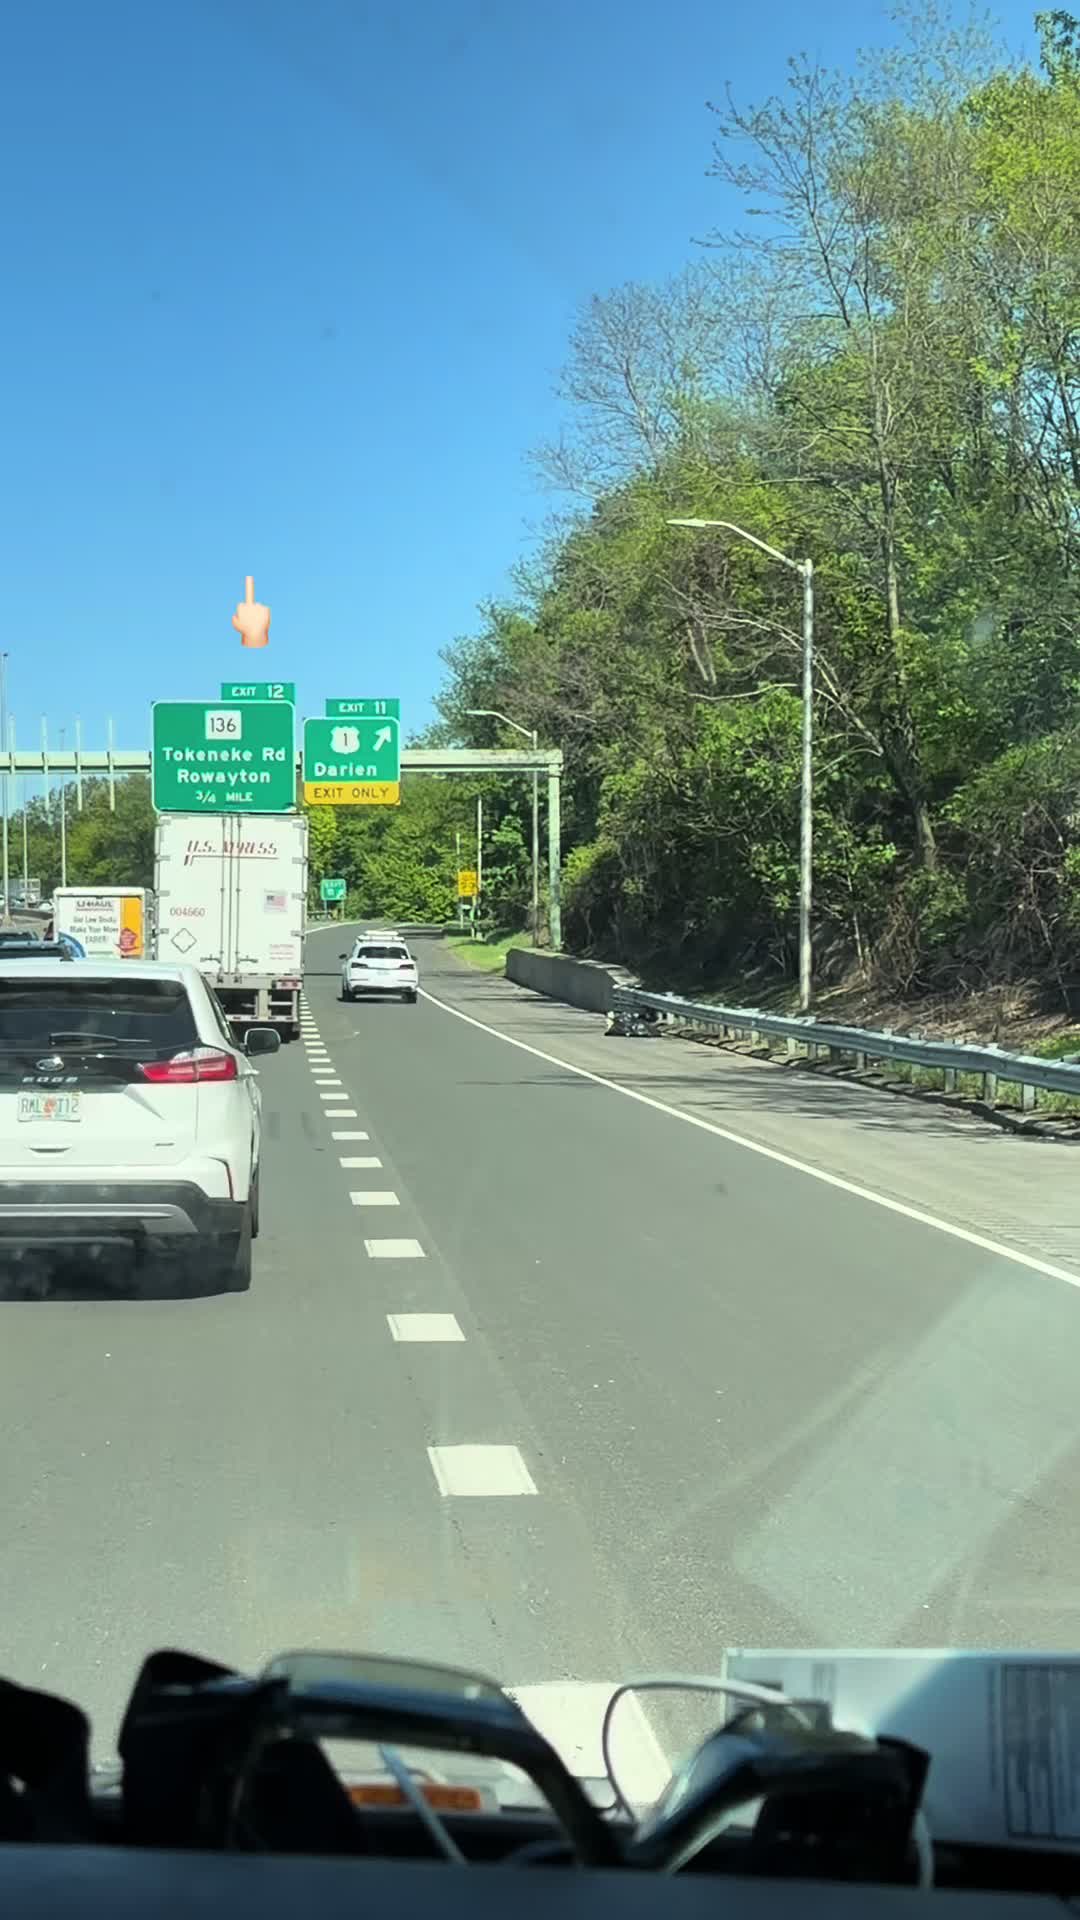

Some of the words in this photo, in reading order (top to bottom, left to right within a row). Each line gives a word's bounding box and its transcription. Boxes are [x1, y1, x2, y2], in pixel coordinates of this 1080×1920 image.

[231, 686, 256, 697] EXIT
[267, 684, 285, 698] 12
[339, 703, 364, 713] EXIT
[375, 701, 387, 714] 11
[209, 717, 237, 733] 136
[342, 732, 349, 747] 1
[162, 747, 253, 762] Tokeneke
[262, 747, 286, 762] Rd
[177, 768, 271, 786] Rowayton
[314, 762, 378, 777] Darien
[226, 792, 254, 802] MILE
[313, 788, 344, 799] EXIT
[352, 787, 390, 799] ONLY
